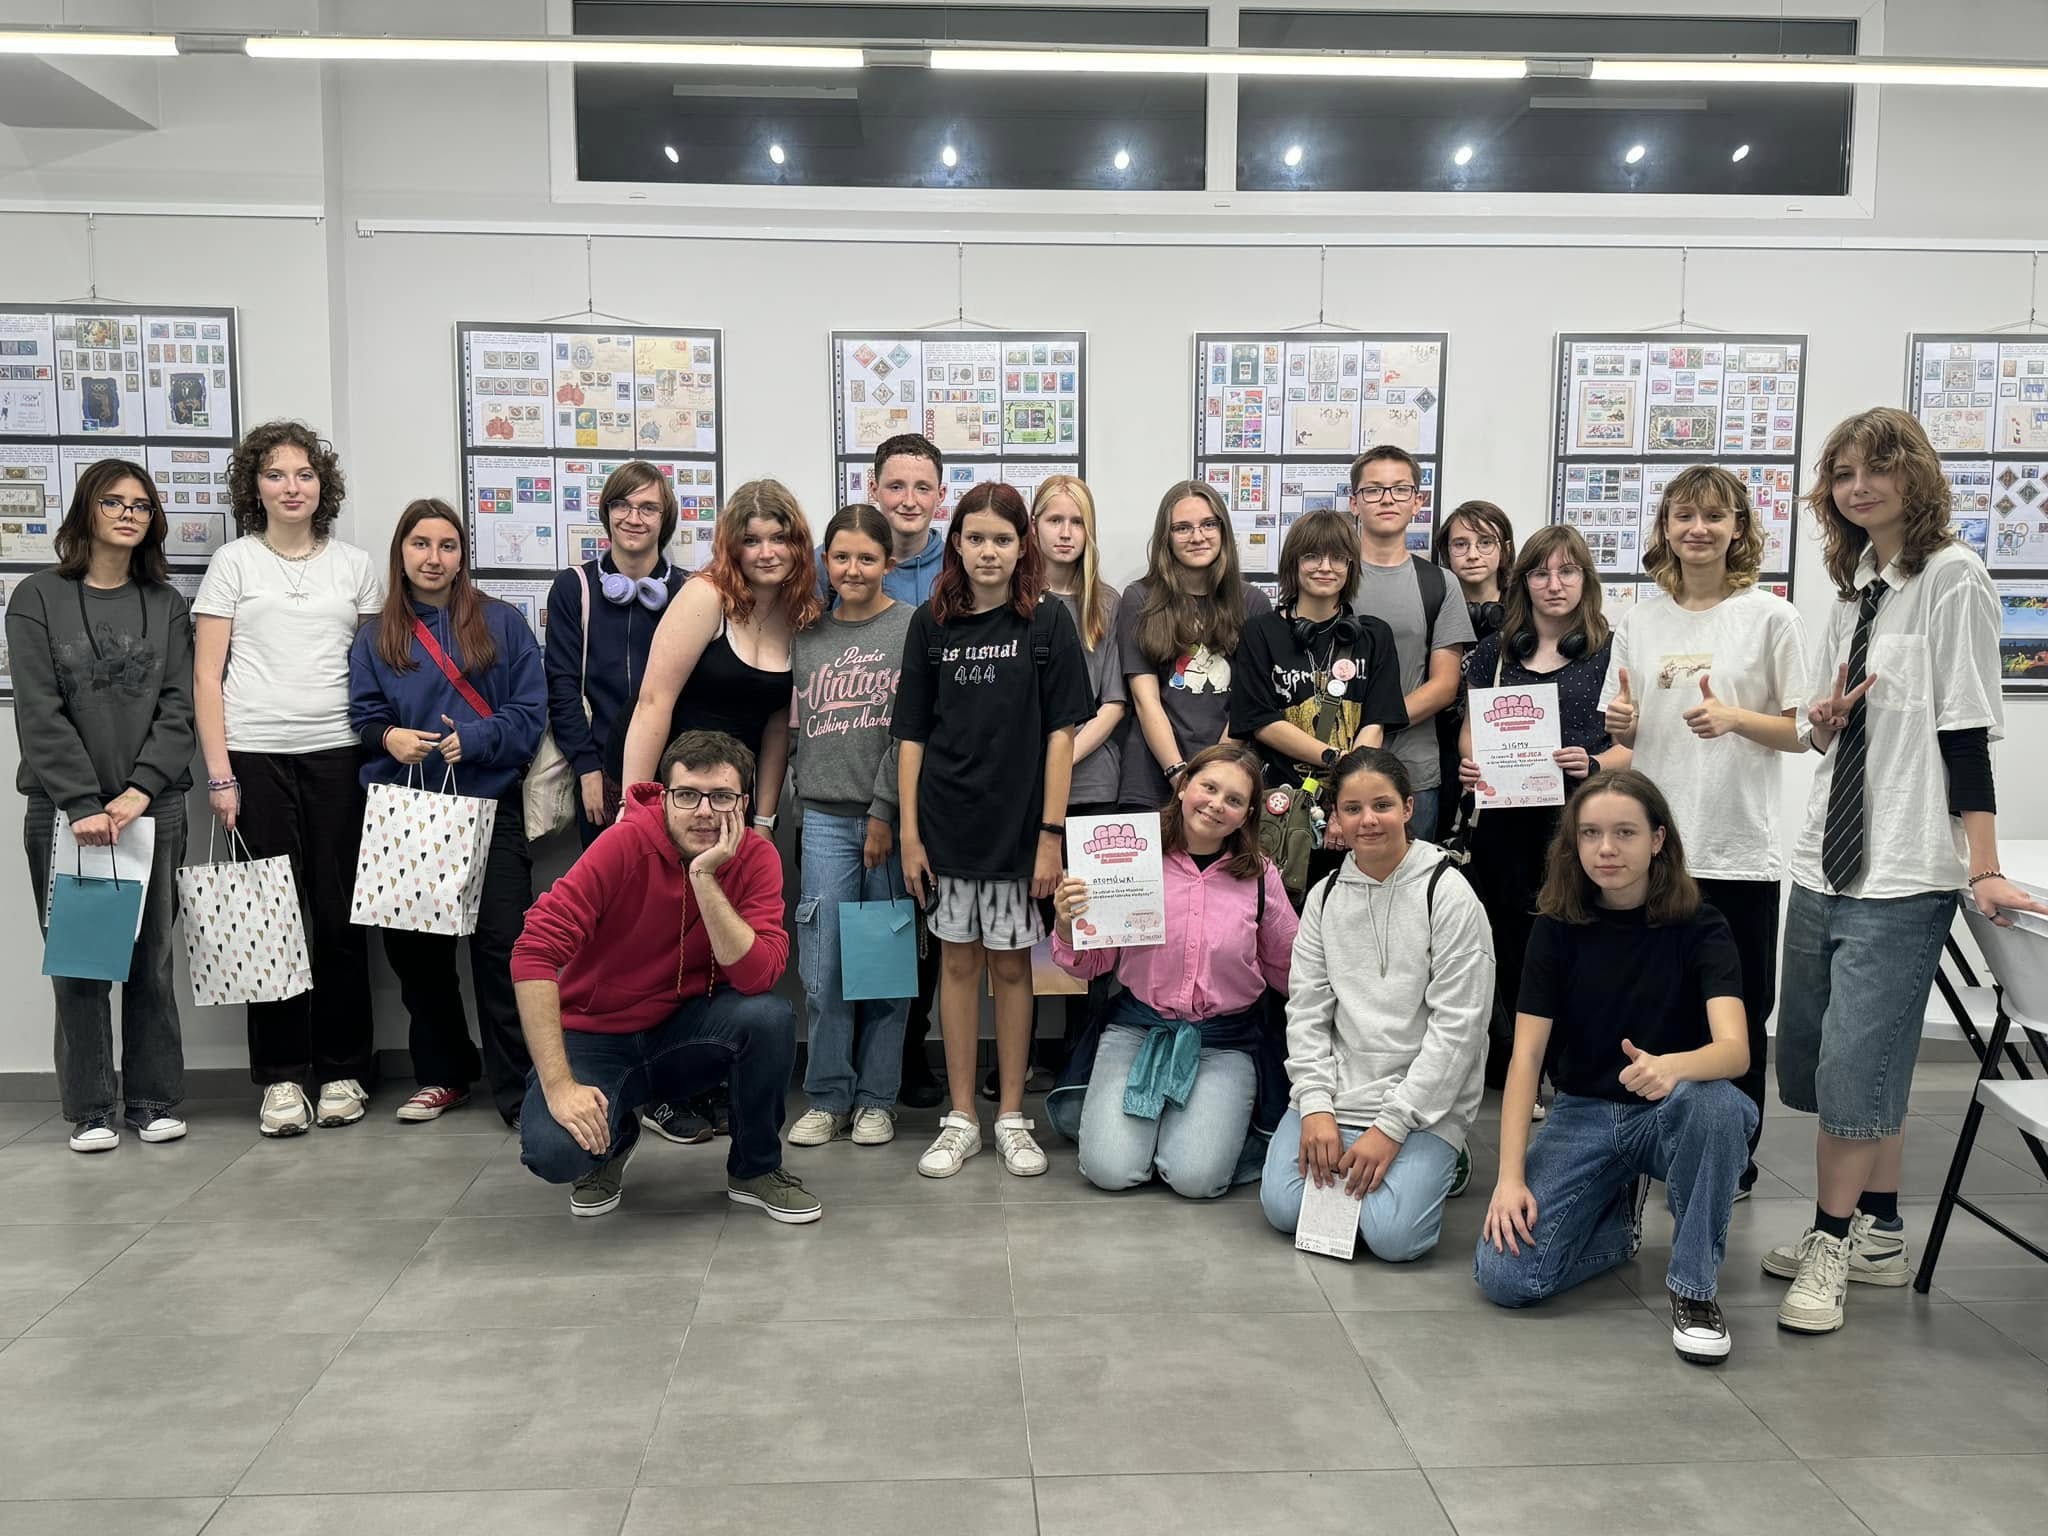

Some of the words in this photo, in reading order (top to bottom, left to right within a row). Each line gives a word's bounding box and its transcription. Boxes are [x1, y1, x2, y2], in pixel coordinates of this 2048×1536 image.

[834, 646, 886, 668] Paris
[965, 640, 1018, 660] usual
[954, 663, 996, 685] 444
[1271, 664, 1316, 703] Cypr
[794, 663, 902, 710] Vintage
[1493, 694, 1534, 710] GRA
[806, 710, 849, 738] Clothing
[853, 704, 892, 728] Marke
[1483, 706, 1545, 723] MIEJSKA
[1502, 742, 1529, 750] SIGMY
[1093, 823, 1137, 840] GRA
[1083, 836, 1148, 854] MIEJSKA
